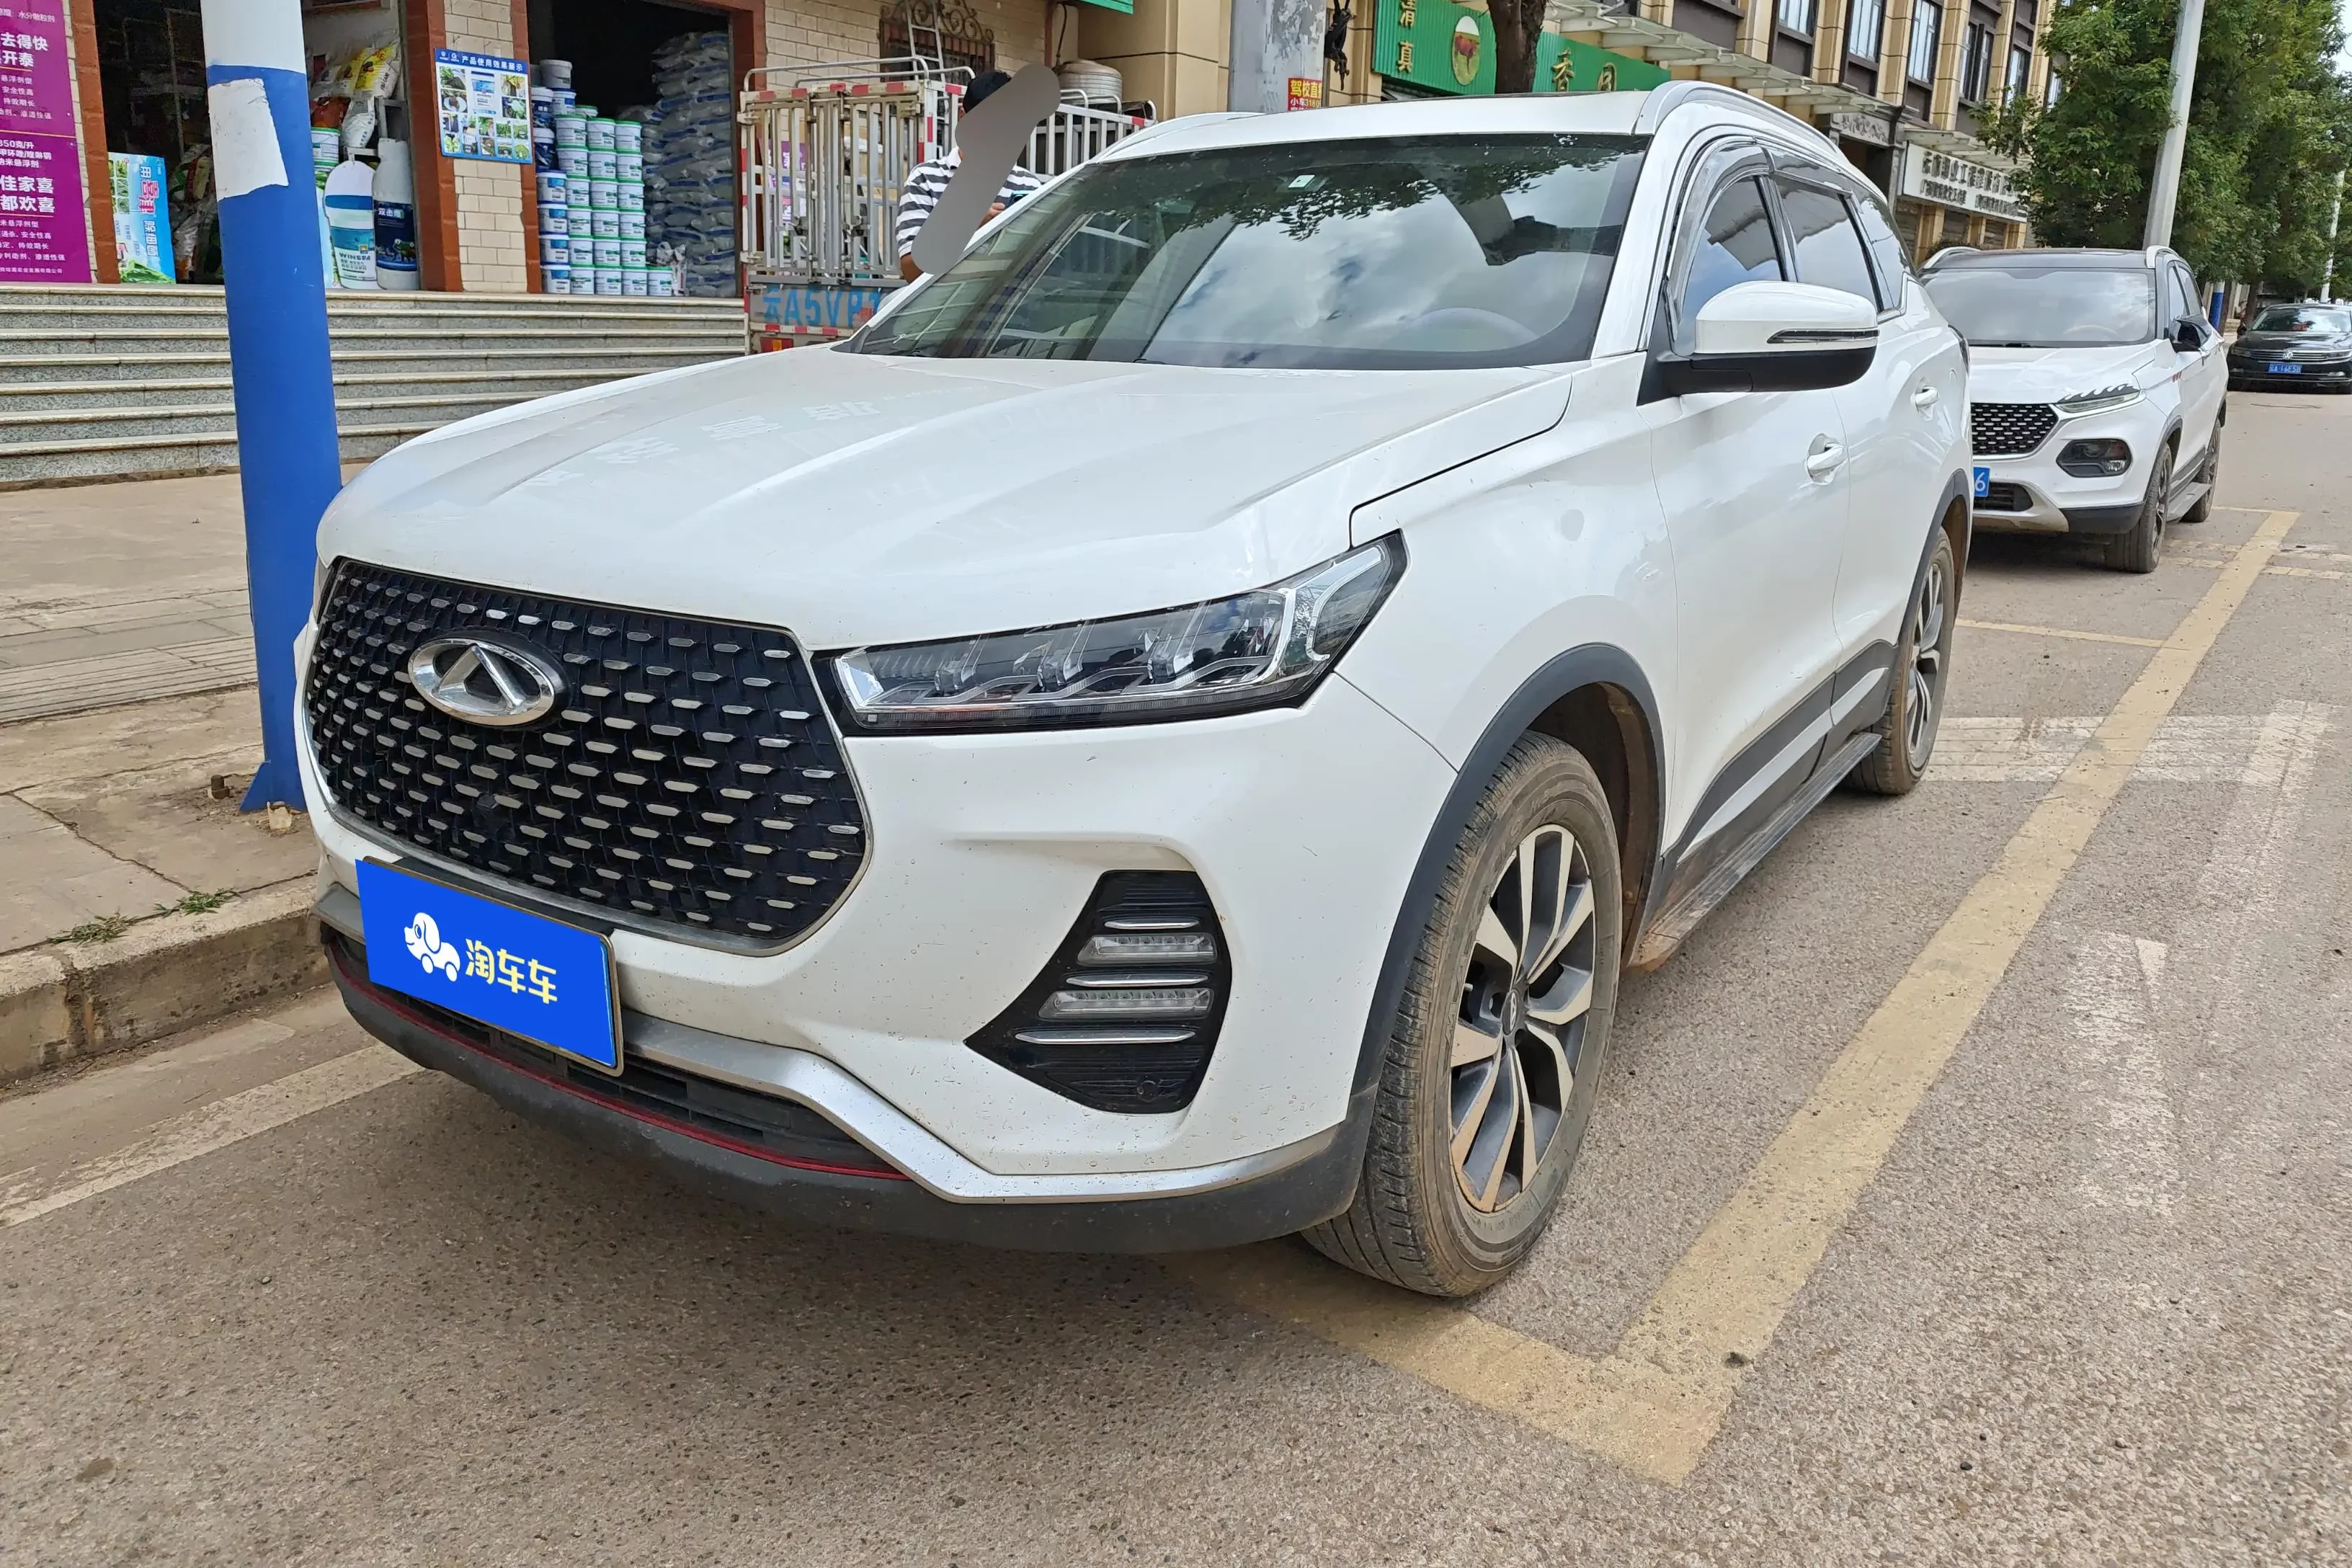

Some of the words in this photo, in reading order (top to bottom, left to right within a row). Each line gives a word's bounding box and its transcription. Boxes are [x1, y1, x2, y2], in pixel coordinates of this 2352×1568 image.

[1, 32, 48, 51] 去得快
[0, 50, 34, 67] 开泰
[461, 55, 523, 72] 产品使用效果展示
[2, 86, 34, 96] 安全性高
[4, 97, 35, 107] 持效期长
[0, 174, 54, 194] 佳家喜
[0, 195, 55, 213] 都欢喜
[0, 241, 49, 250] 定、持效期长
